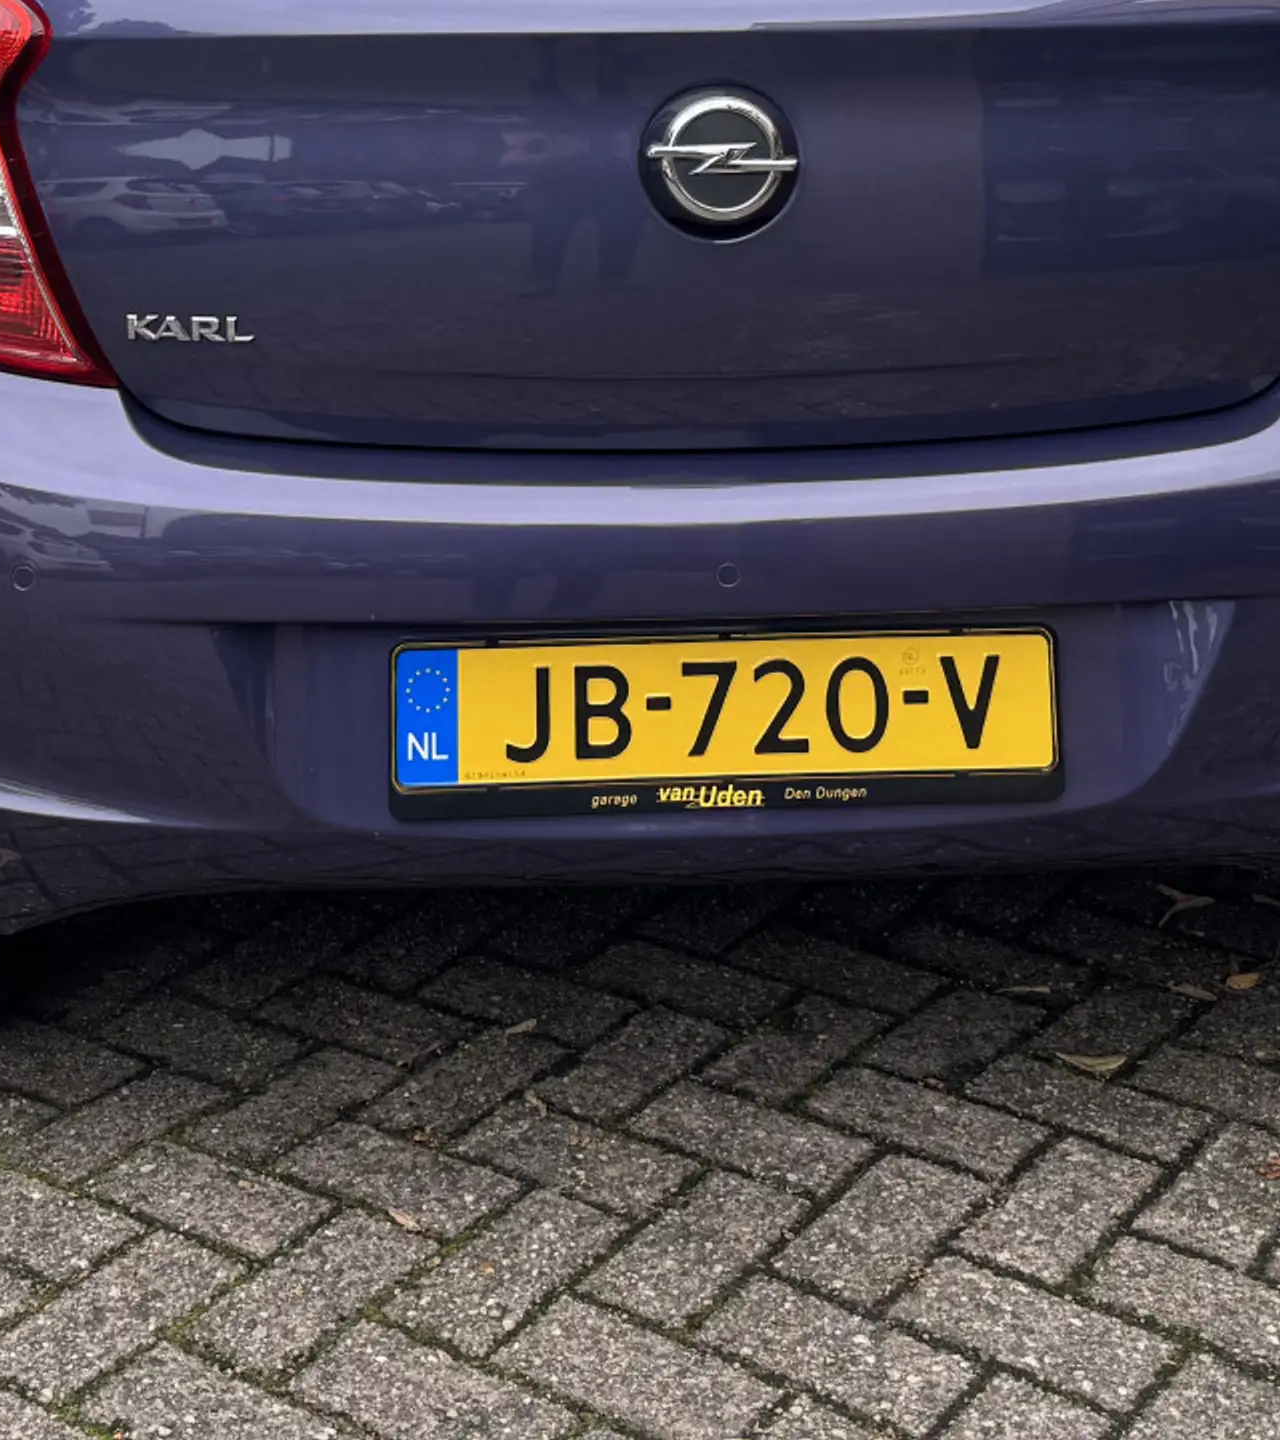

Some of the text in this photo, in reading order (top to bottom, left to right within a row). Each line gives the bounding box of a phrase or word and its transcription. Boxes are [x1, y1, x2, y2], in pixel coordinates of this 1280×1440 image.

[126, 313, 256, 342] KARL
[504, 654, 1001, 764] JB-720-V
[406, 732, 449, 761] NL
[591, 784, 868, 808] garage van Uden Den Dungen
